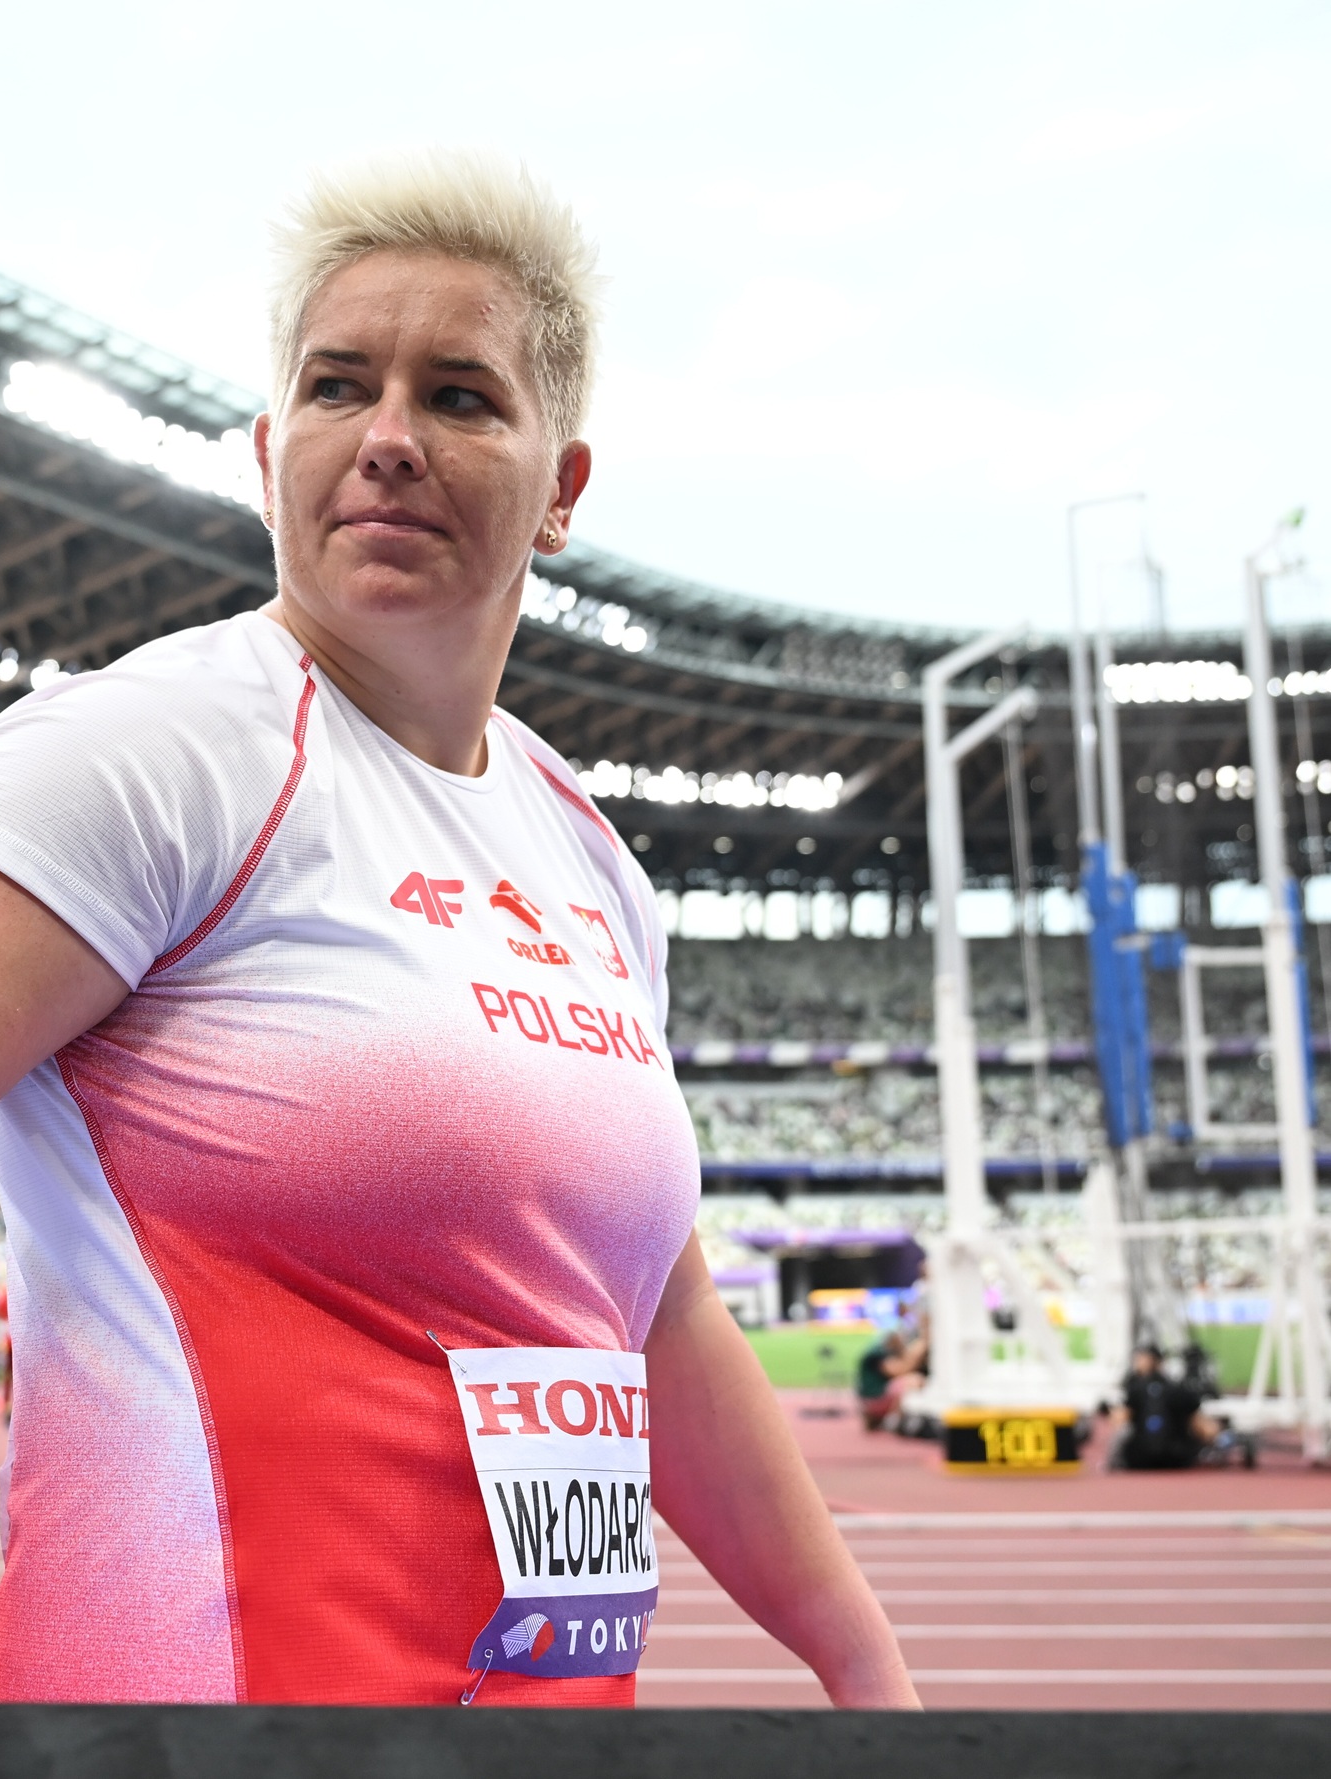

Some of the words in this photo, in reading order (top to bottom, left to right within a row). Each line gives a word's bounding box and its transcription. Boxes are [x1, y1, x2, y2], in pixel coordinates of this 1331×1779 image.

[390, 871, 465, 929] 4F
[470, 982, 665, 1071] POLSKA
[494, 1478, 651, 1577] WŁODARC
